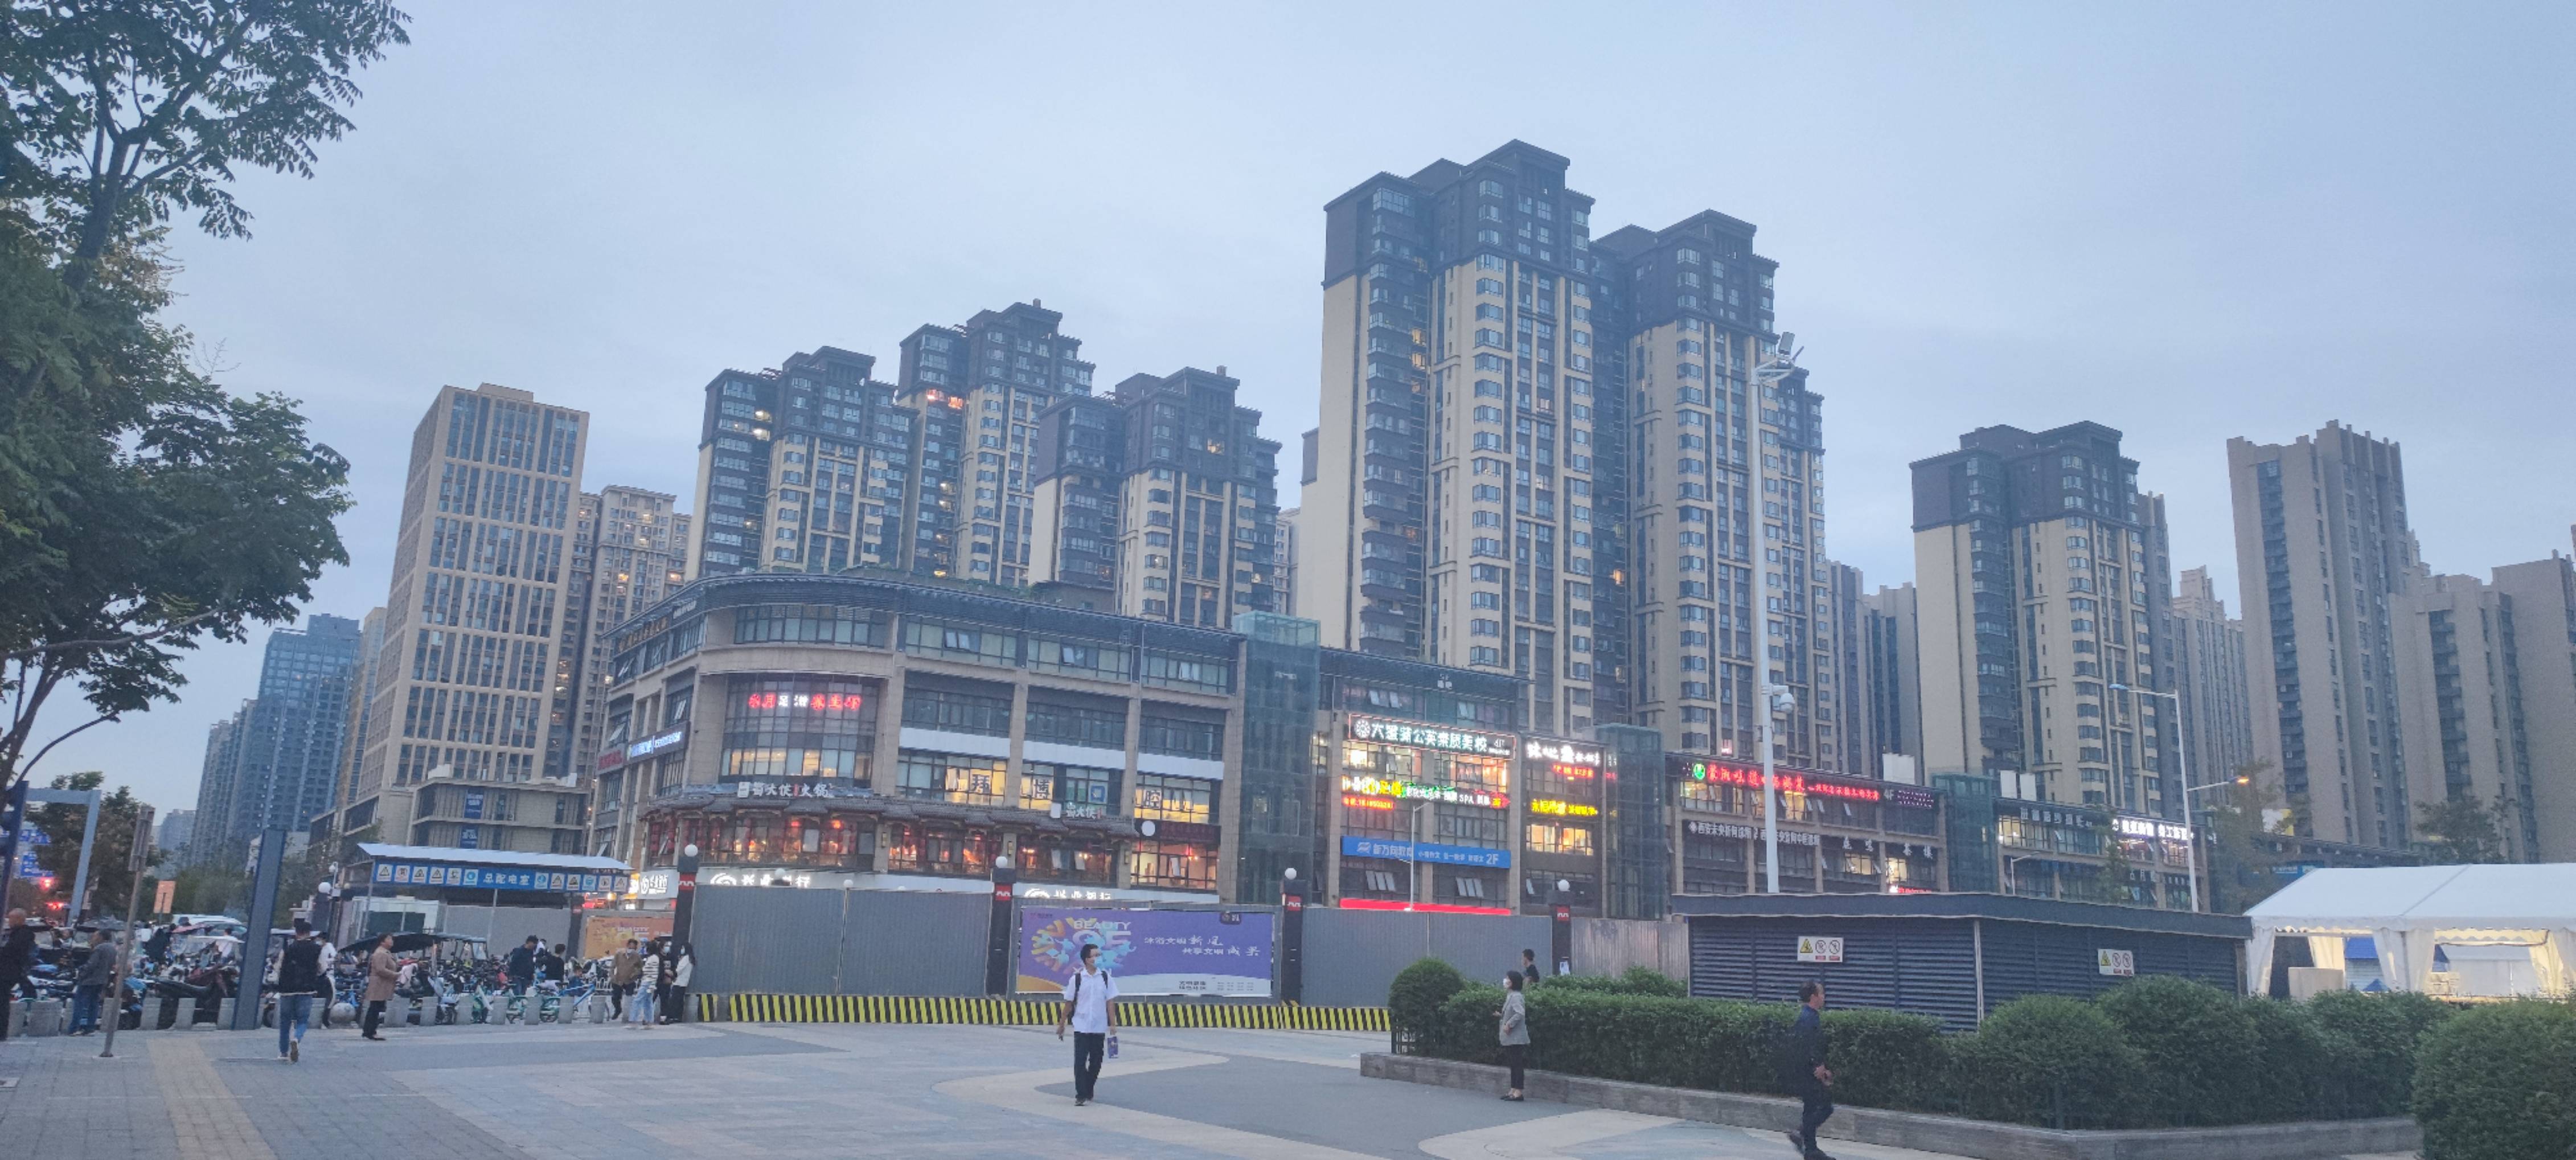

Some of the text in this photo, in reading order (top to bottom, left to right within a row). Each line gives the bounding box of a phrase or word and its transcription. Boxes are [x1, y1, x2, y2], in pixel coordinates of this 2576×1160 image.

[1459, 794, 1474, 804] SPA
[1486, 854, 1499, 865] 2F
[483, 873, 530, 886] 总配电室
[741, 874, 811, 888] 兴业行
